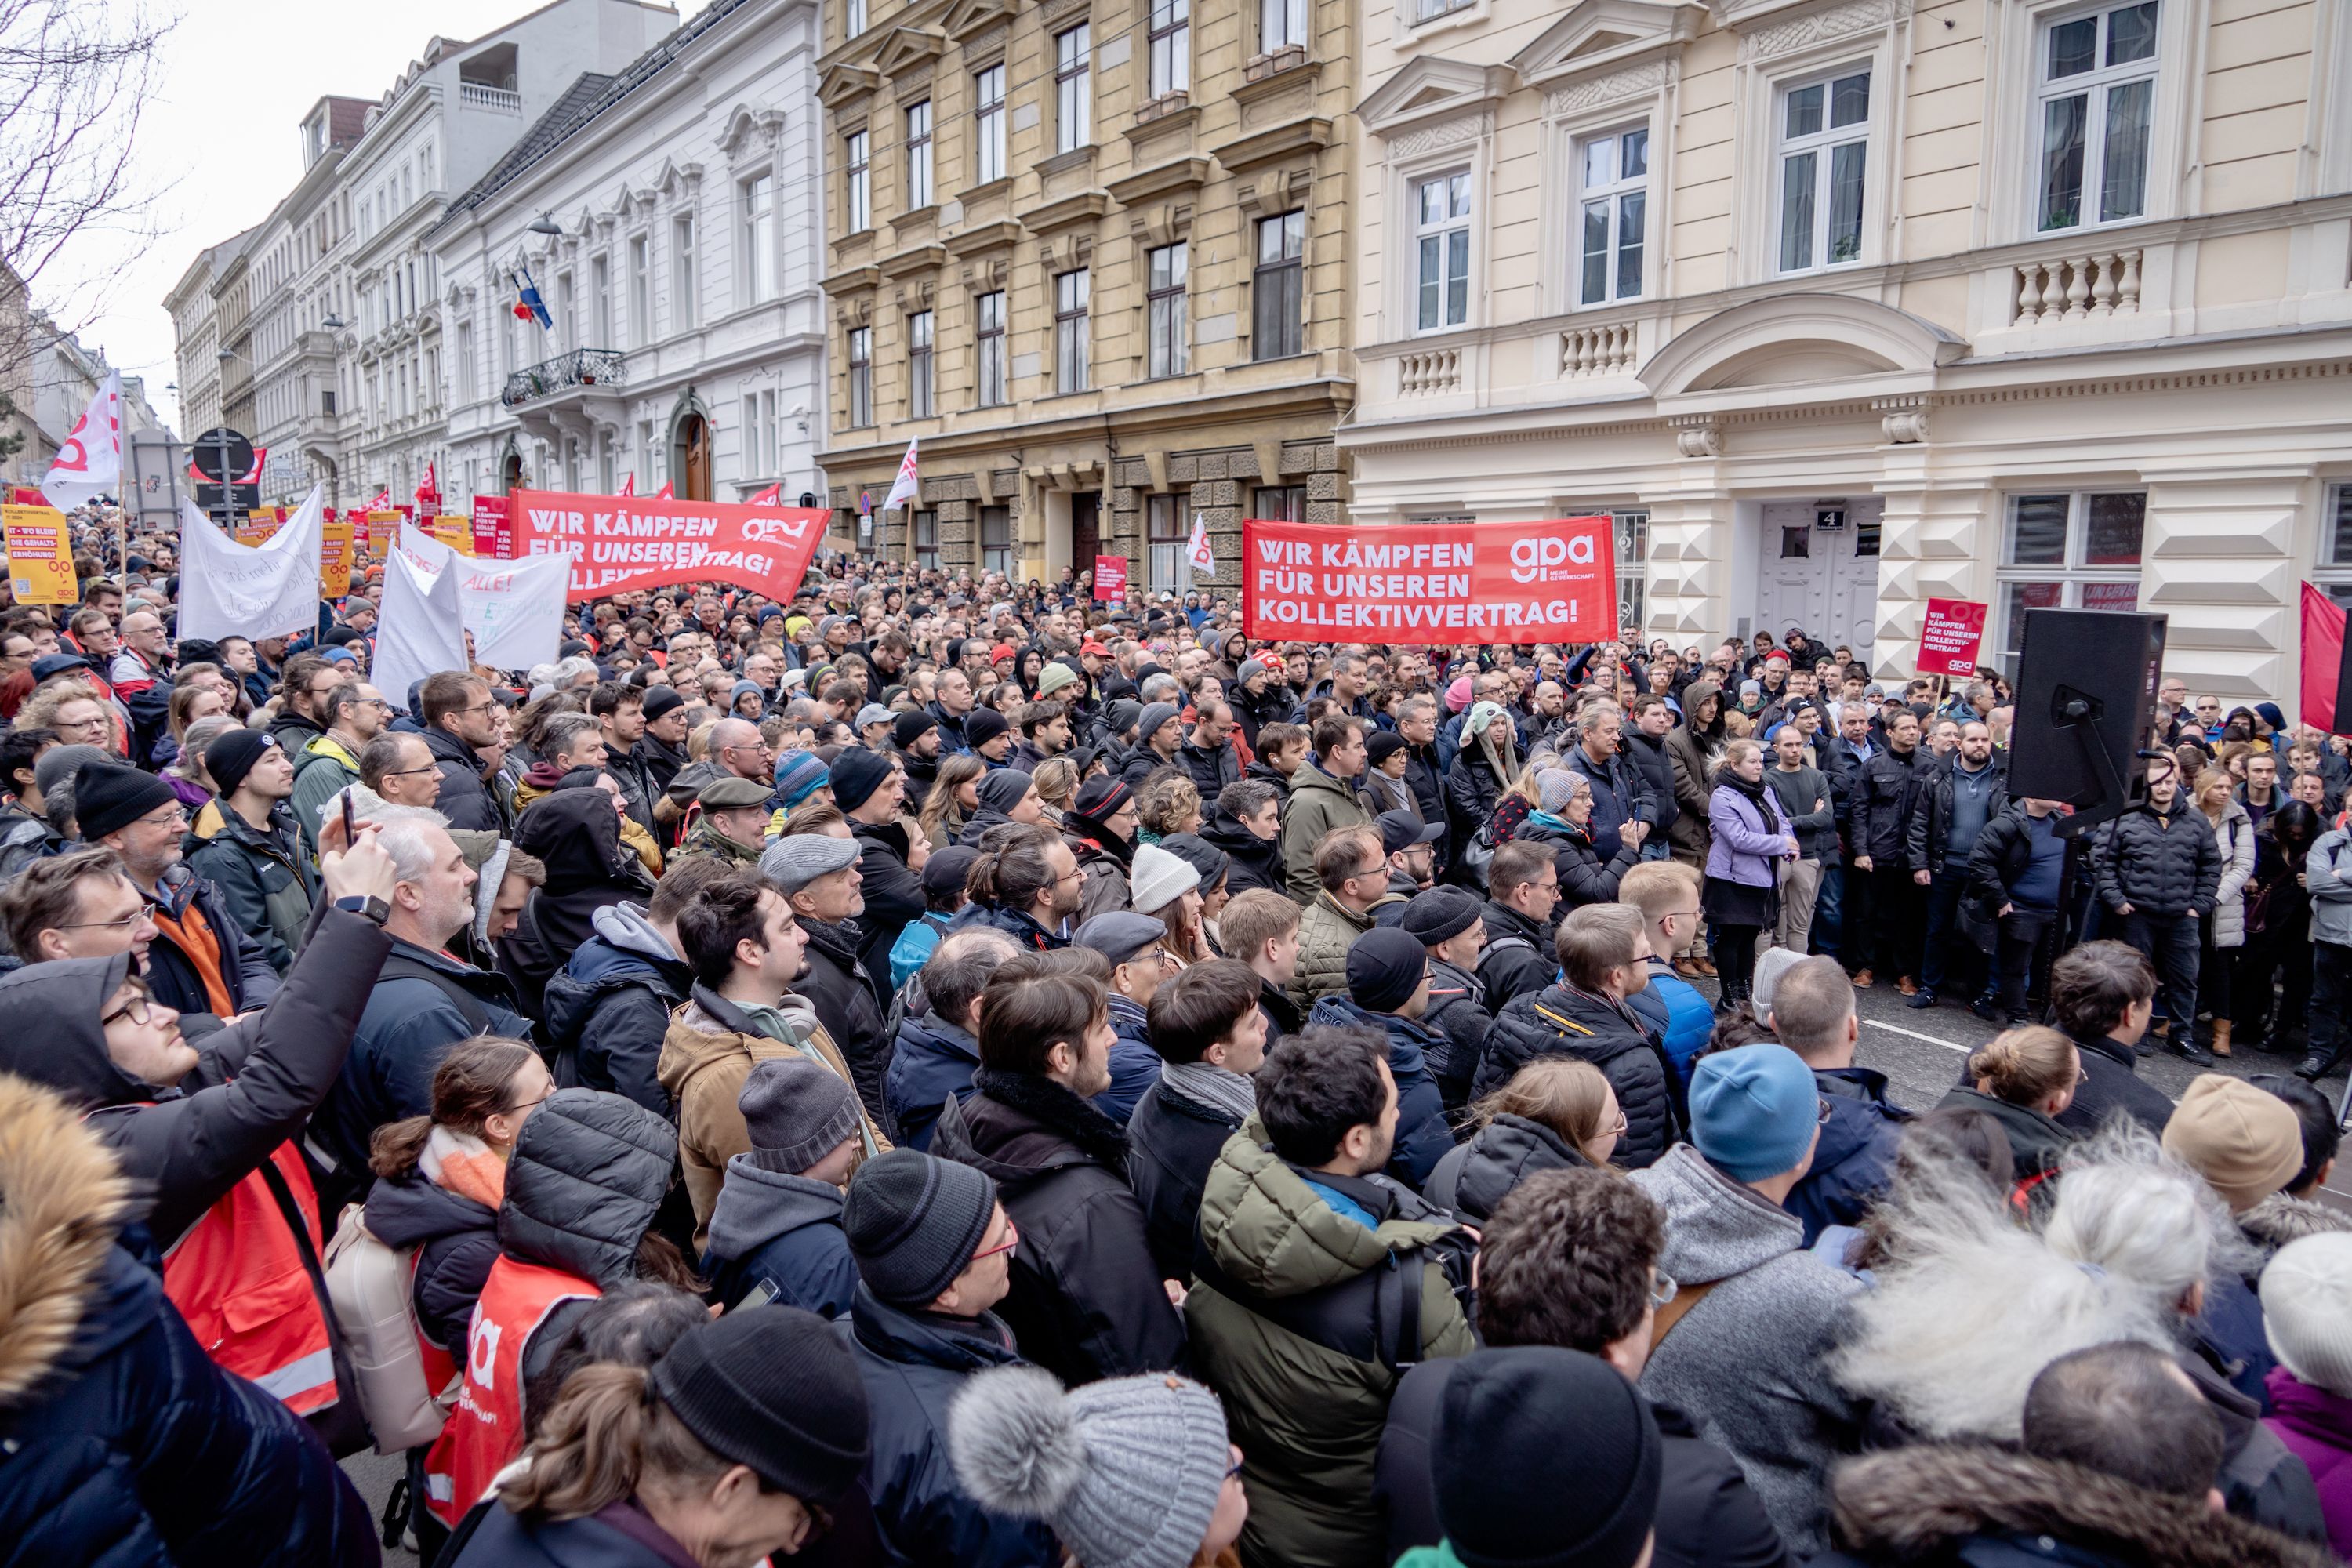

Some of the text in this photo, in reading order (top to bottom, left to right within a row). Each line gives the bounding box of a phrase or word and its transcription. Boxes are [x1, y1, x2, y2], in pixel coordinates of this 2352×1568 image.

[528, 510, 718, 538] WIR KÄMPFEN
[1824, 512, 1836, 526] 4
[529, 535, 709, 566] FÜR UNSEREN
[1258, 539, 1474, 568] WIR KÄMPFEN
[1510, 535, 1594, 583] gpa
[462, 575, 514, 592] ALLE!
[1259, 565, 1468, 598] FÜR UNSEREN
[57, 590, 74, 599] gpa
[1259, 599, 1577, 628] KOLLEKTIVVERTRAG!
[1928, 619, 1965, 630] KÄMPFEN
[1925, 635, 1969, 646] KOLLEKTIV-
[1926, 627, 1980, 640] FÜR UNSEREN
[1924, 643, 1961, 653] VERTRAG!
[1948, 659, 1973, 671] gpa
